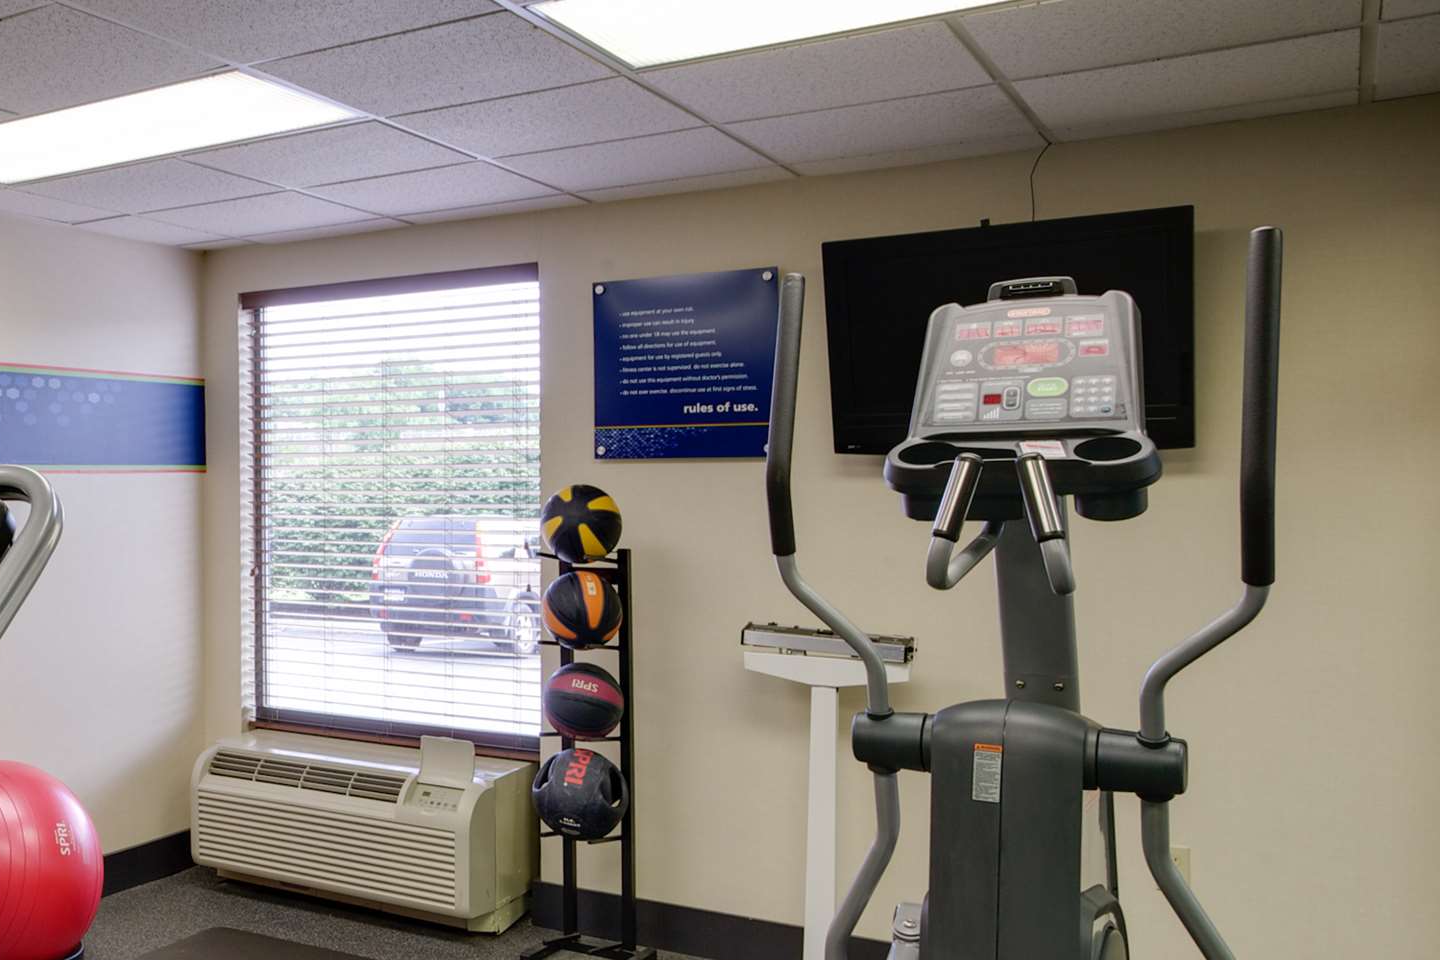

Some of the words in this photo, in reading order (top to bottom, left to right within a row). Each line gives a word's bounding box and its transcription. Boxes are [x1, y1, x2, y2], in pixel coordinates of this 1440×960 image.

[683, 402, 714, 414] rules
[716, 401, 731, 413] of
[733, 403, 759, 412] use.
[571, 678, 600, 693] SPRI
